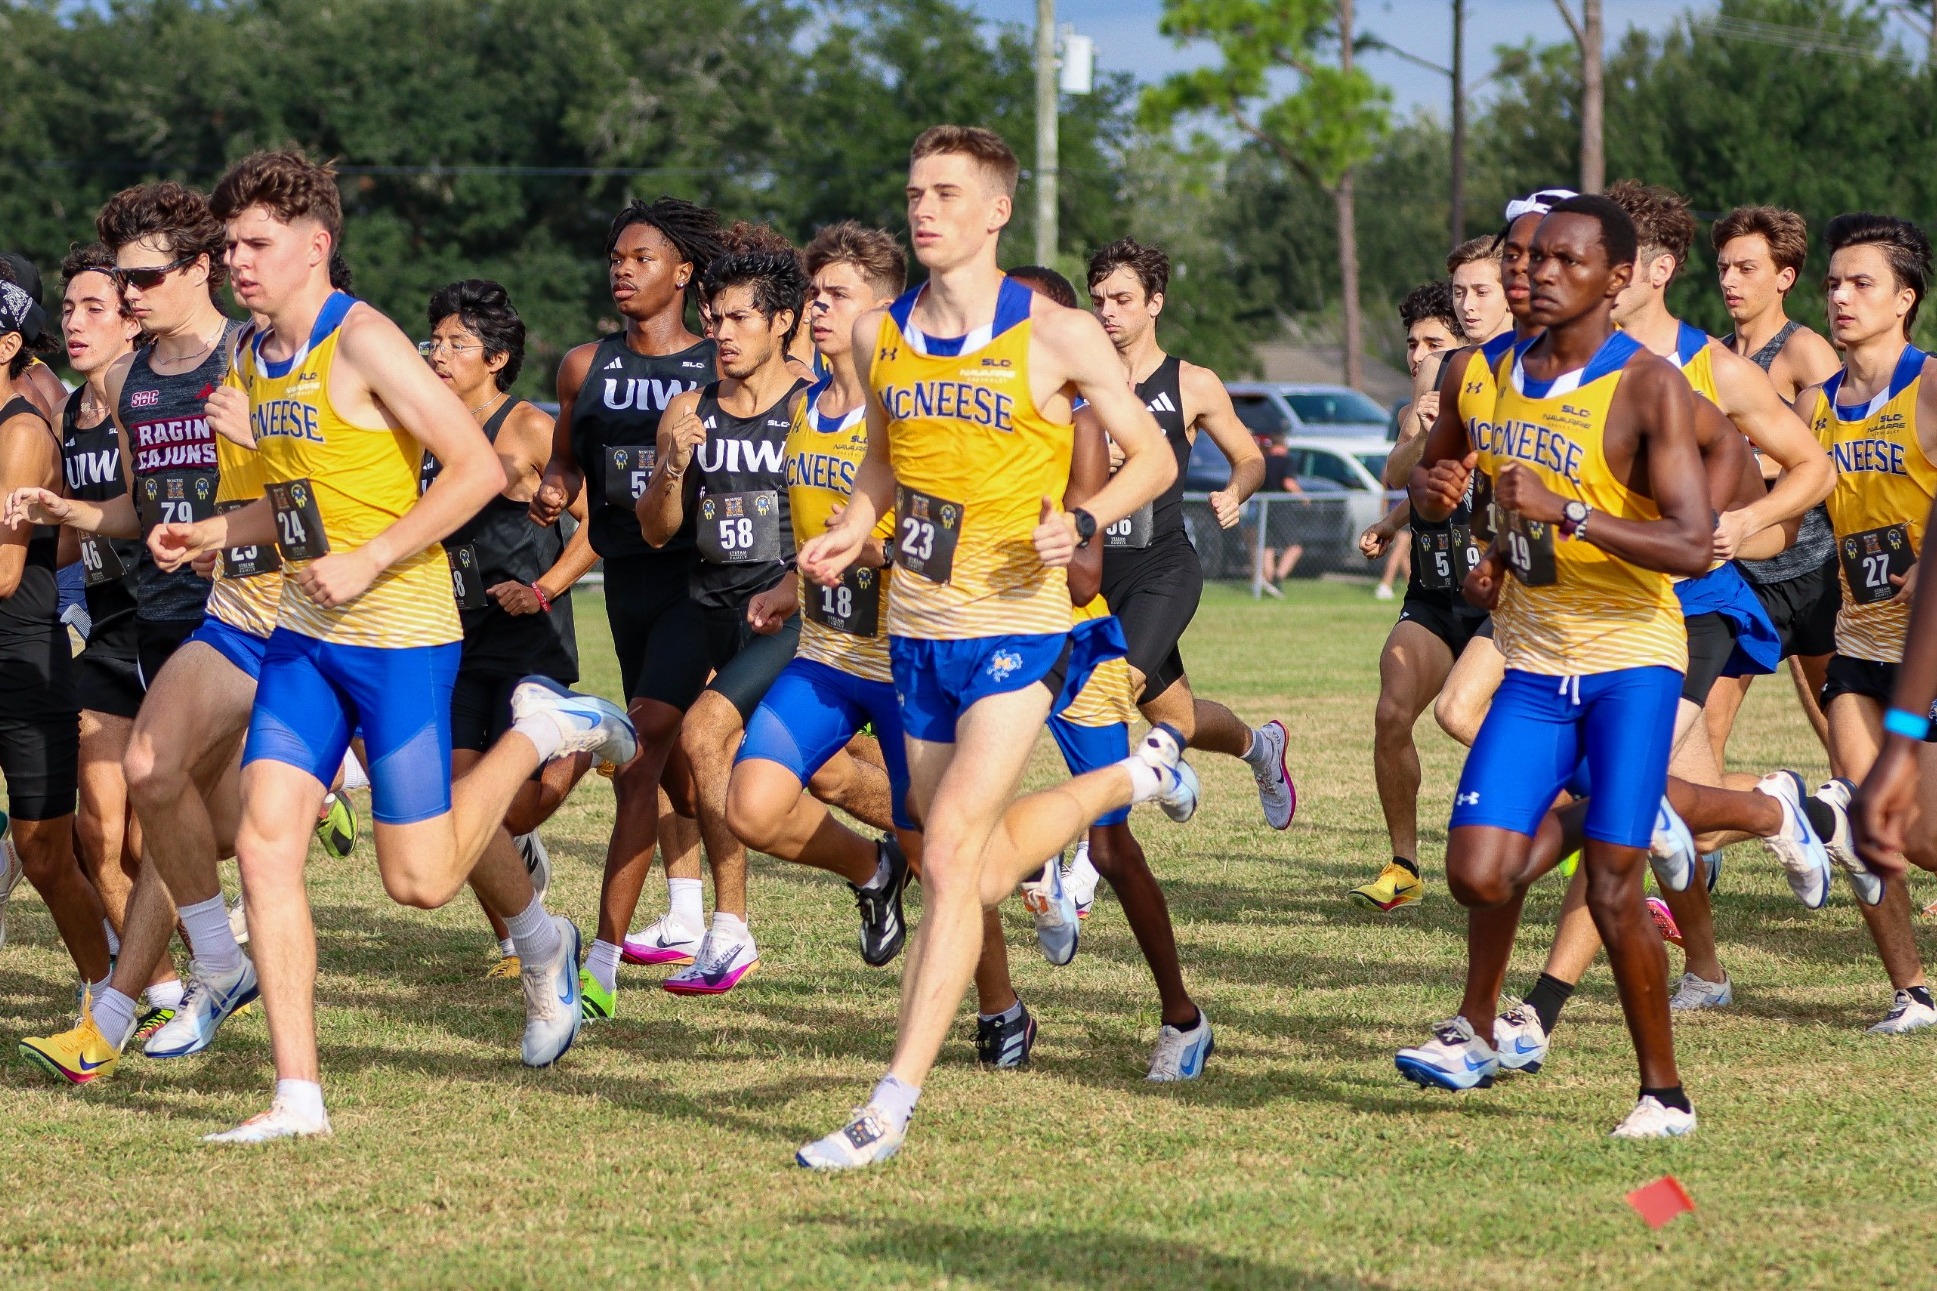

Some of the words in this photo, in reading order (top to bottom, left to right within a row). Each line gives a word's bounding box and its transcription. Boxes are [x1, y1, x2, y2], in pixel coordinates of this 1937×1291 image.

[682, 360, 705, 369] SLC
[981, 358, 1012, 368] SLC
[131, 389, 160, 408] SBC
[1561, 404, 1592, 418] SLC
[108, 427, 119, 435] SL
[138, 417, 212, 448] RAGIN
[250, 400, 325, 444] cNEESE
[767, 419, 791, 429] SLC
[1880, 414, 1904, 423] SLC
[138, 442, 219, 471] CAJUNS
[697, 437, 788, 474] UIW
[1491, 418, 1585, 486] cNEESE
[66, 447, 120, 491] UIW
[631, 470, 653, 500] 5
[160, 501, 193, 526] 79
[277, 510, 307, 545] 24
[719, 517, 754, 550] 58
[901, 517, 935, 561] 23
[81, 540, 103, 571] 46
[1507, 531, 1532, 571] 19
[453, 570, 466, 598] 8
[1862, 553, 1890, 588] 27
[821, 584, 852, 619] 18
